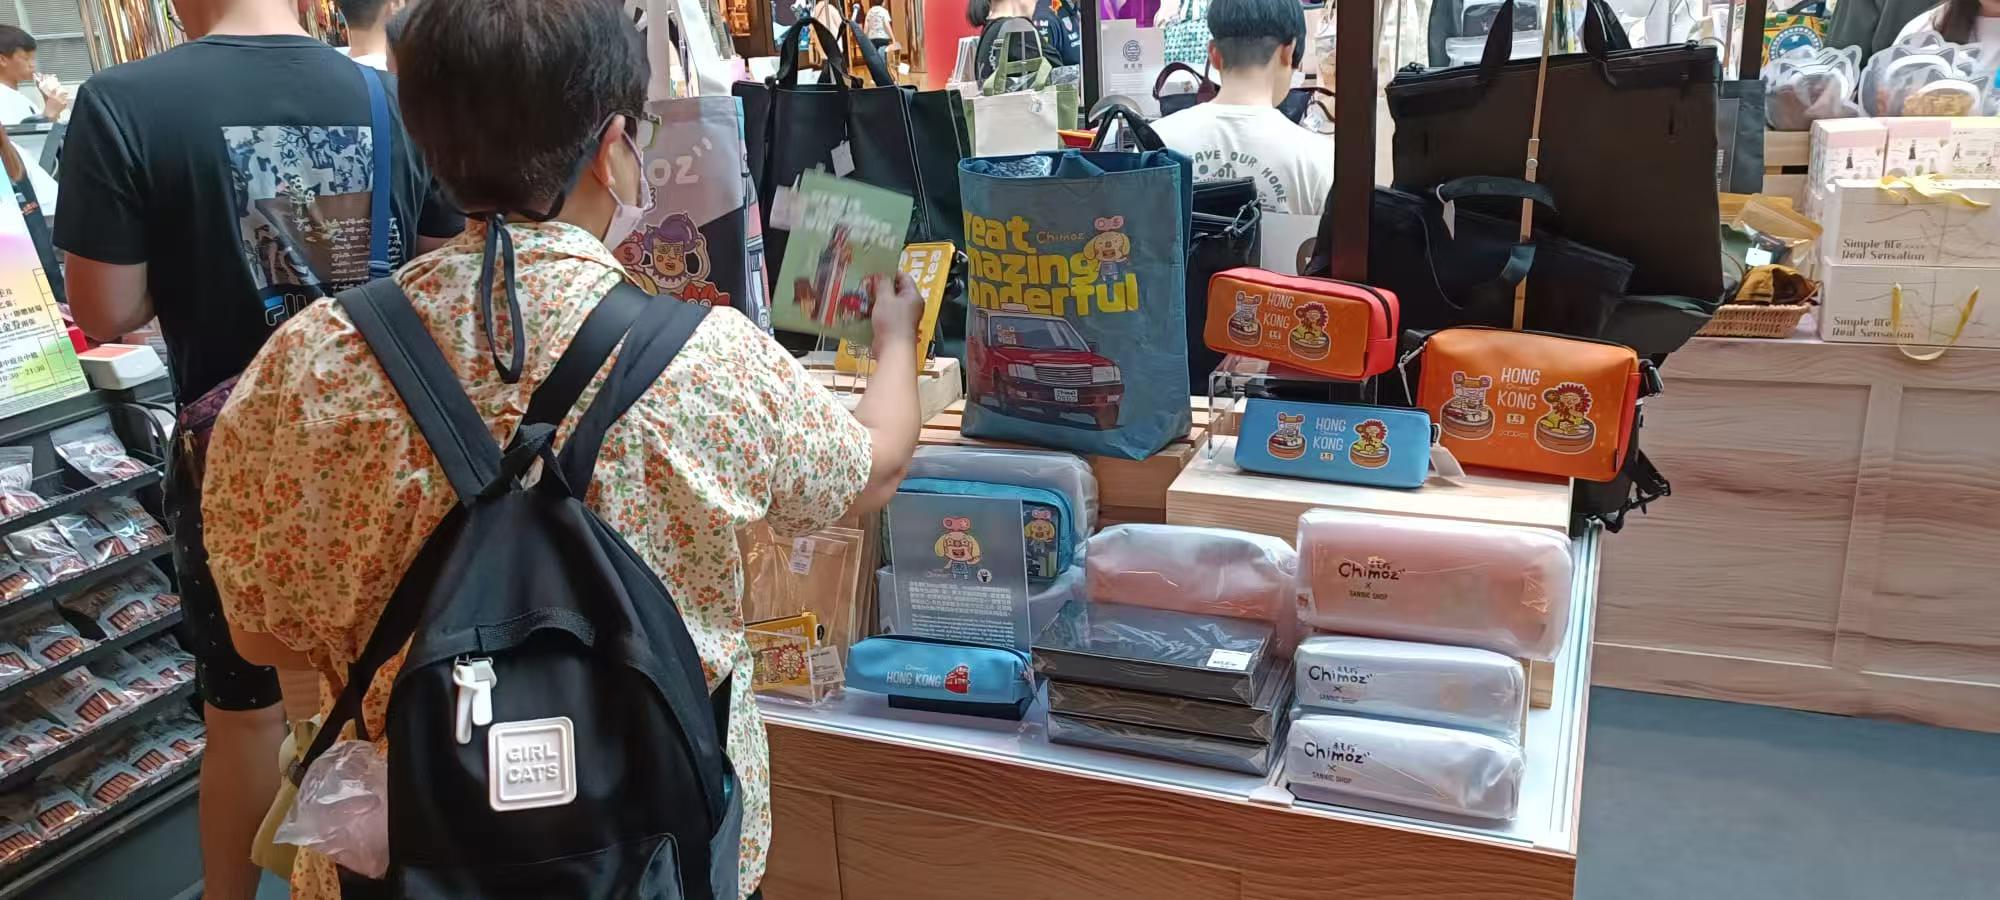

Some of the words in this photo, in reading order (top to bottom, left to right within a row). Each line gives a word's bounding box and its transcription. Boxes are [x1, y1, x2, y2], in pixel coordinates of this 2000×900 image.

[1194, 150, 1221, 163] AVE
[1230, 151, 1258, 169] OUR
[1261, 167, 1287, 204] HOME
[1843, 240, 1880, 252] Simple
[1842, 250, 1866, 260] Real
[1266, 291, 1295, 309] HONG
[1263, 312, 1291, 329] KONG
[1834, 316, 1870, 328] Simple
[1501, 367, 1541, 385] HONG
[1497, 390, 1537, 410] KONG
[1315, 417, 1347, 431] HONG
[1313, 436, 1344, 450] KONG
[886, 671, 913, 685] HONG
[915, 673, 941, 688] KONG
[506, 743, 558, 763] GIRL
[506, 763, 558, 784] CATS
